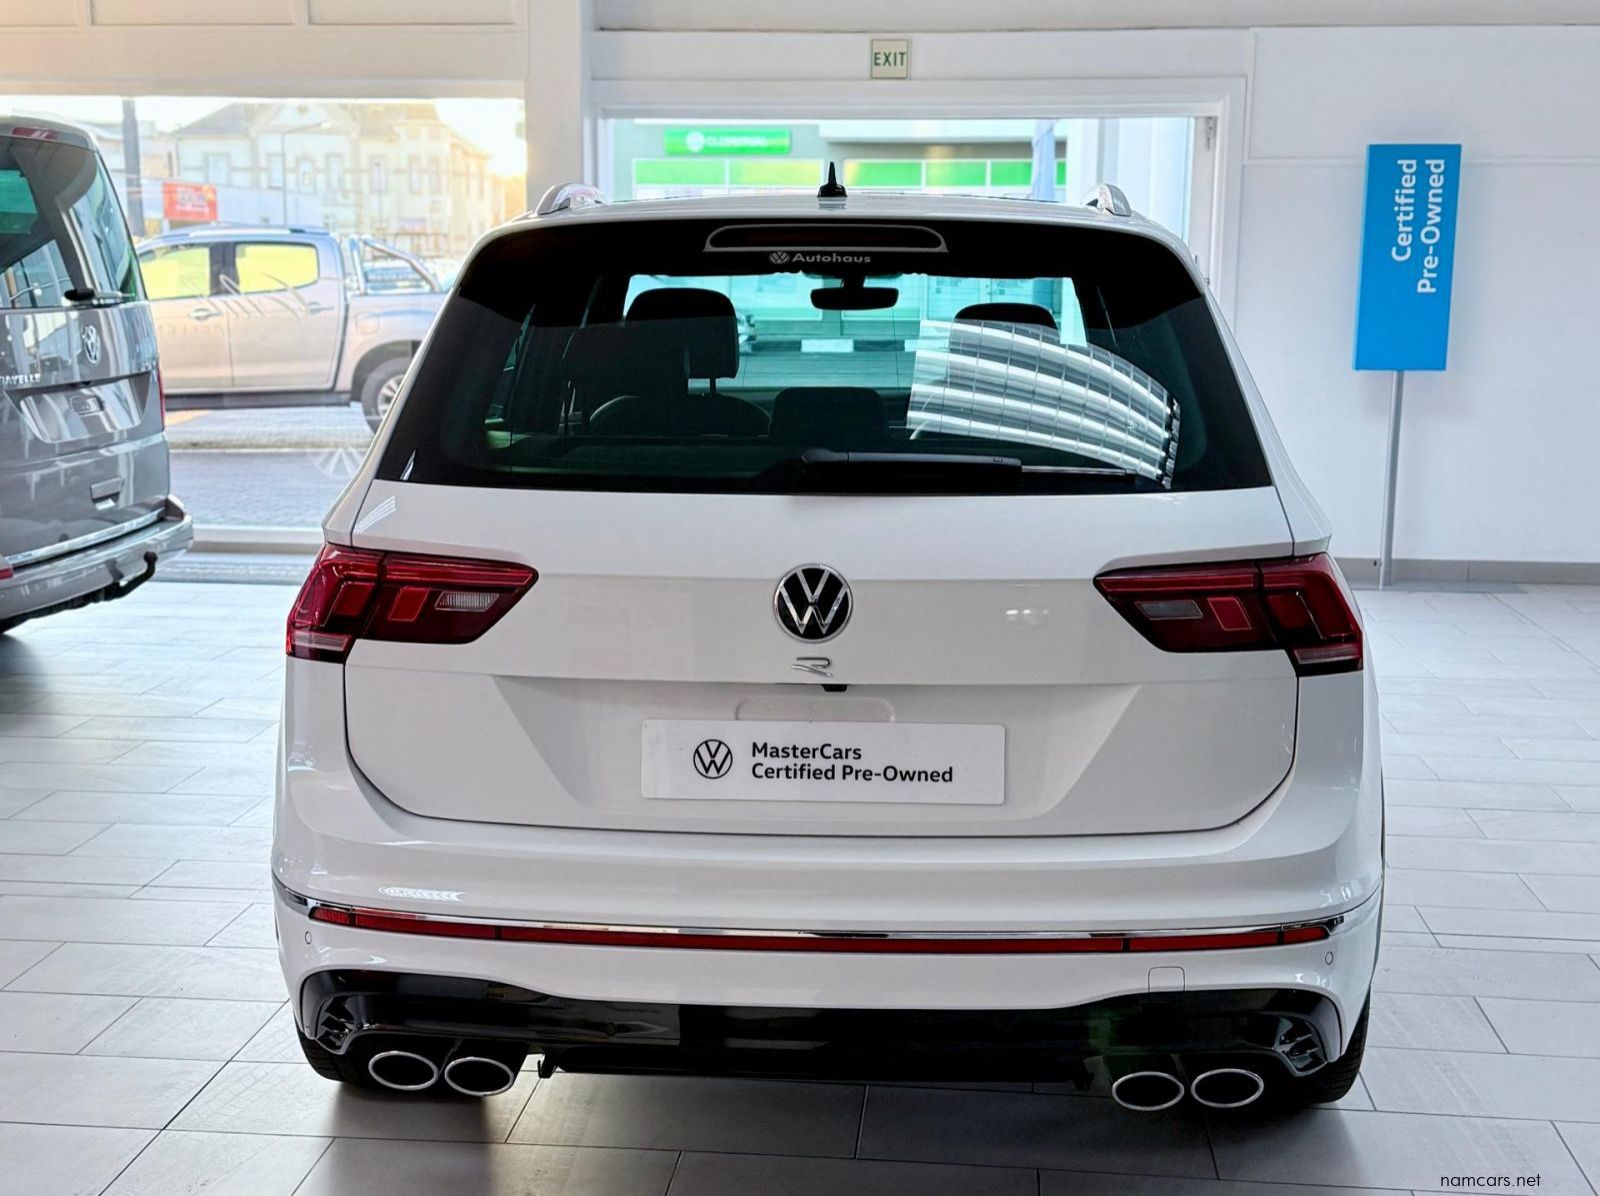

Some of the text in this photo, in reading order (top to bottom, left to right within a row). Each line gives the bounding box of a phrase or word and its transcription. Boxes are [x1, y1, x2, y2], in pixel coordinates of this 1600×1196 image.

[873, 51, 907, 67] EXIT
[1391, 159, 1417, 262] Certified
[1416, 159, 1445, 293] Pre-Owned
[792, 253, 872, 263] Autohaus
[752, 742, 862, 760] MasterCars
[752, 762, 953, 782] Certified Pre-Owned
